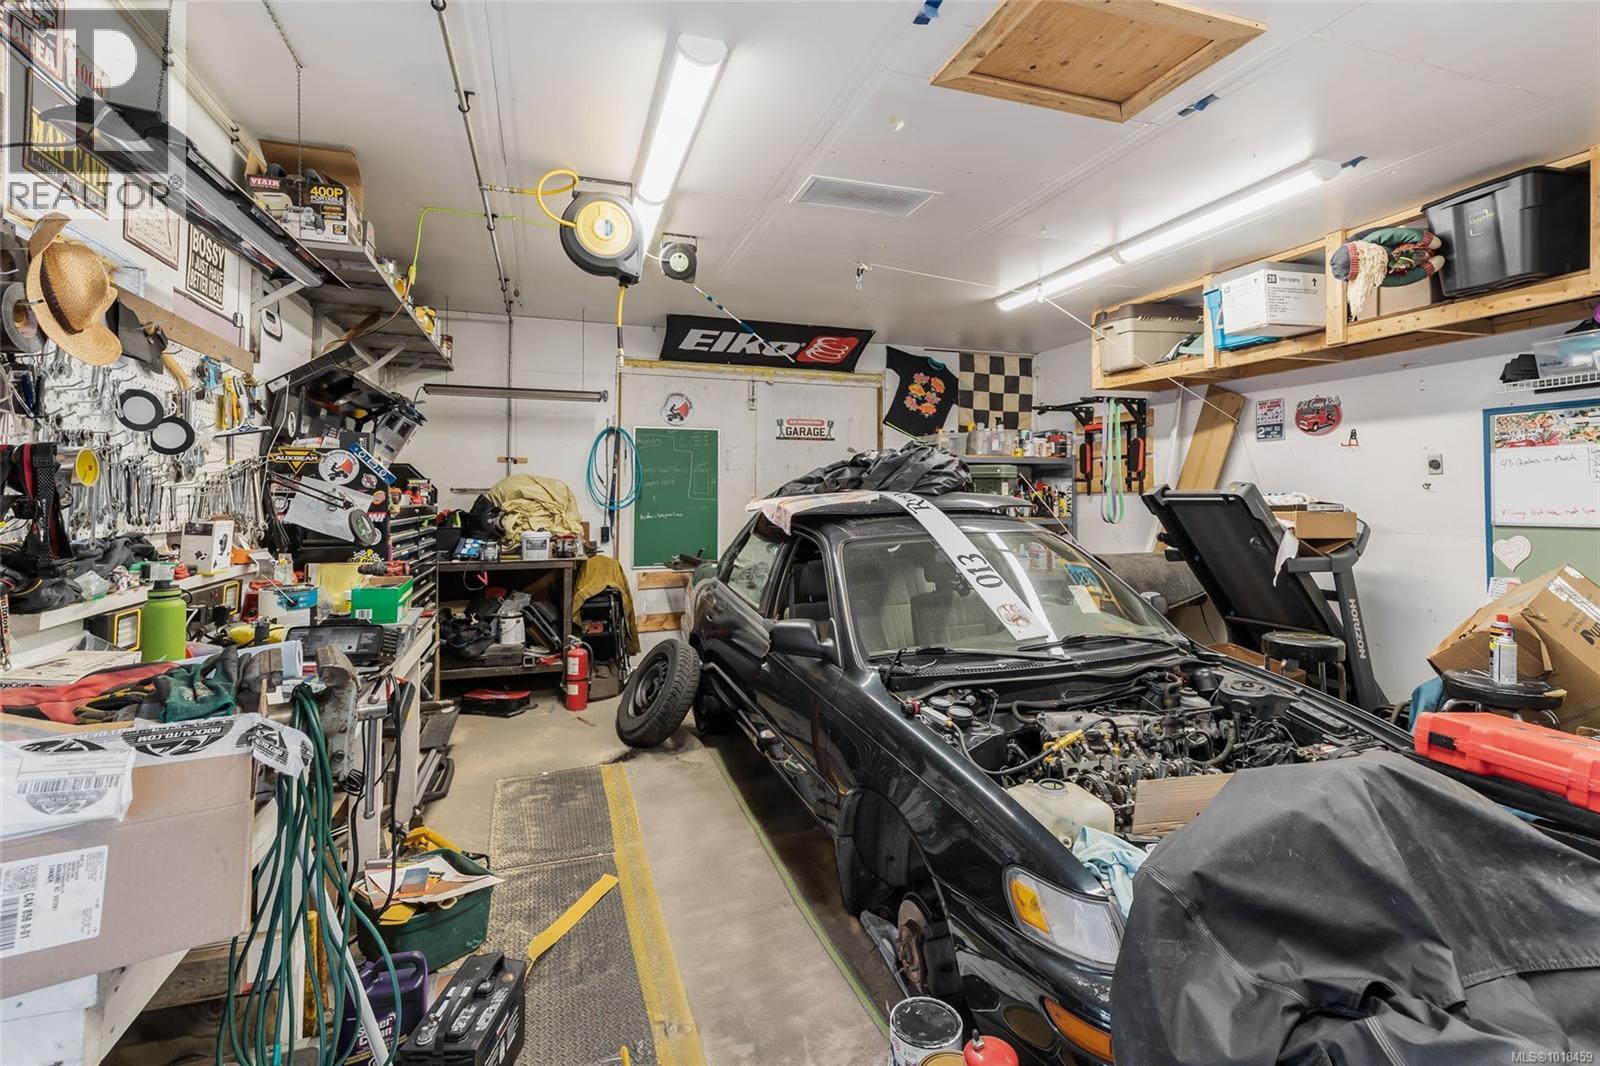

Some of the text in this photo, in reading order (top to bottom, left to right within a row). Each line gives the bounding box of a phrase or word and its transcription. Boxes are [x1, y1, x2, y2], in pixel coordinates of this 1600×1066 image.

[250, 177, 280, 188] VIAIR
[310, 186, 343, 198] 400P
[192, 228, 225, 268] BOSSY
[195, 256, 208, 276] JUST
[209, 264, 224, 285] HAVE
[190, 269, 208, 296] BETTER
[785, 427, 826, 437] GARAGE
[957, 553, 1004, 589] 013
[1348, 598, 1367, 659] HORIZON
[136, 726, 223, 743] ROCKAUTO.COM
[23, 892, 35, 908] CAN
